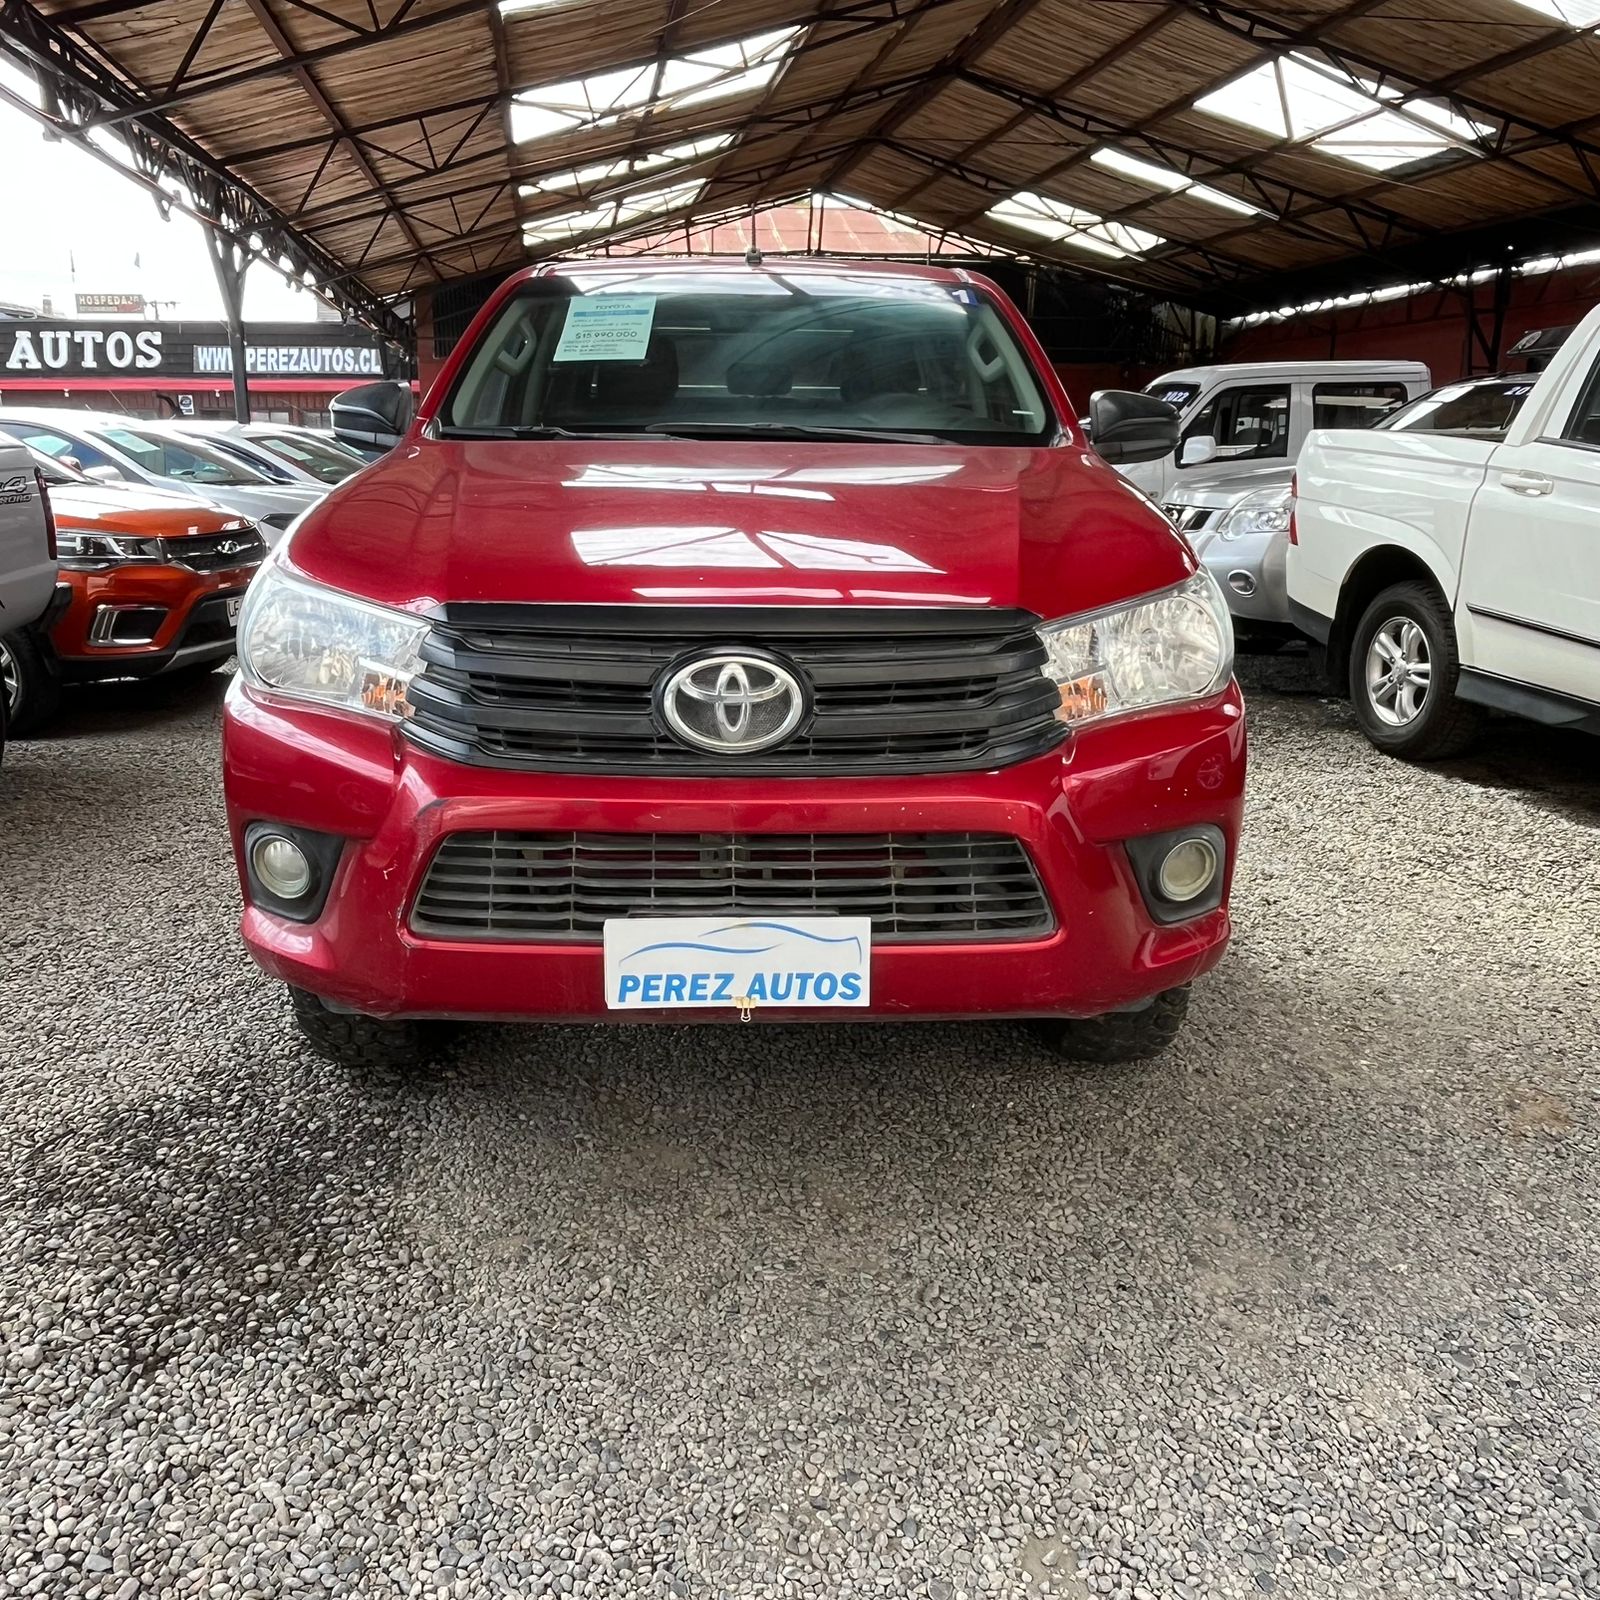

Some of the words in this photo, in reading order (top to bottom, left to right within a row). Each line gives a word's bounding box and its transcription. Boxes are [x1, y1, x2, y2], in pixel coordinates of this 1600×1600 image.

[6, 330, 162, 369] AUTOS
[197, 347, 382, 373] WWPEREZAUTOS.CL
[617, 973, 735, 1003] PEREZ
[745, 971, 862, 1001] AUTOS
